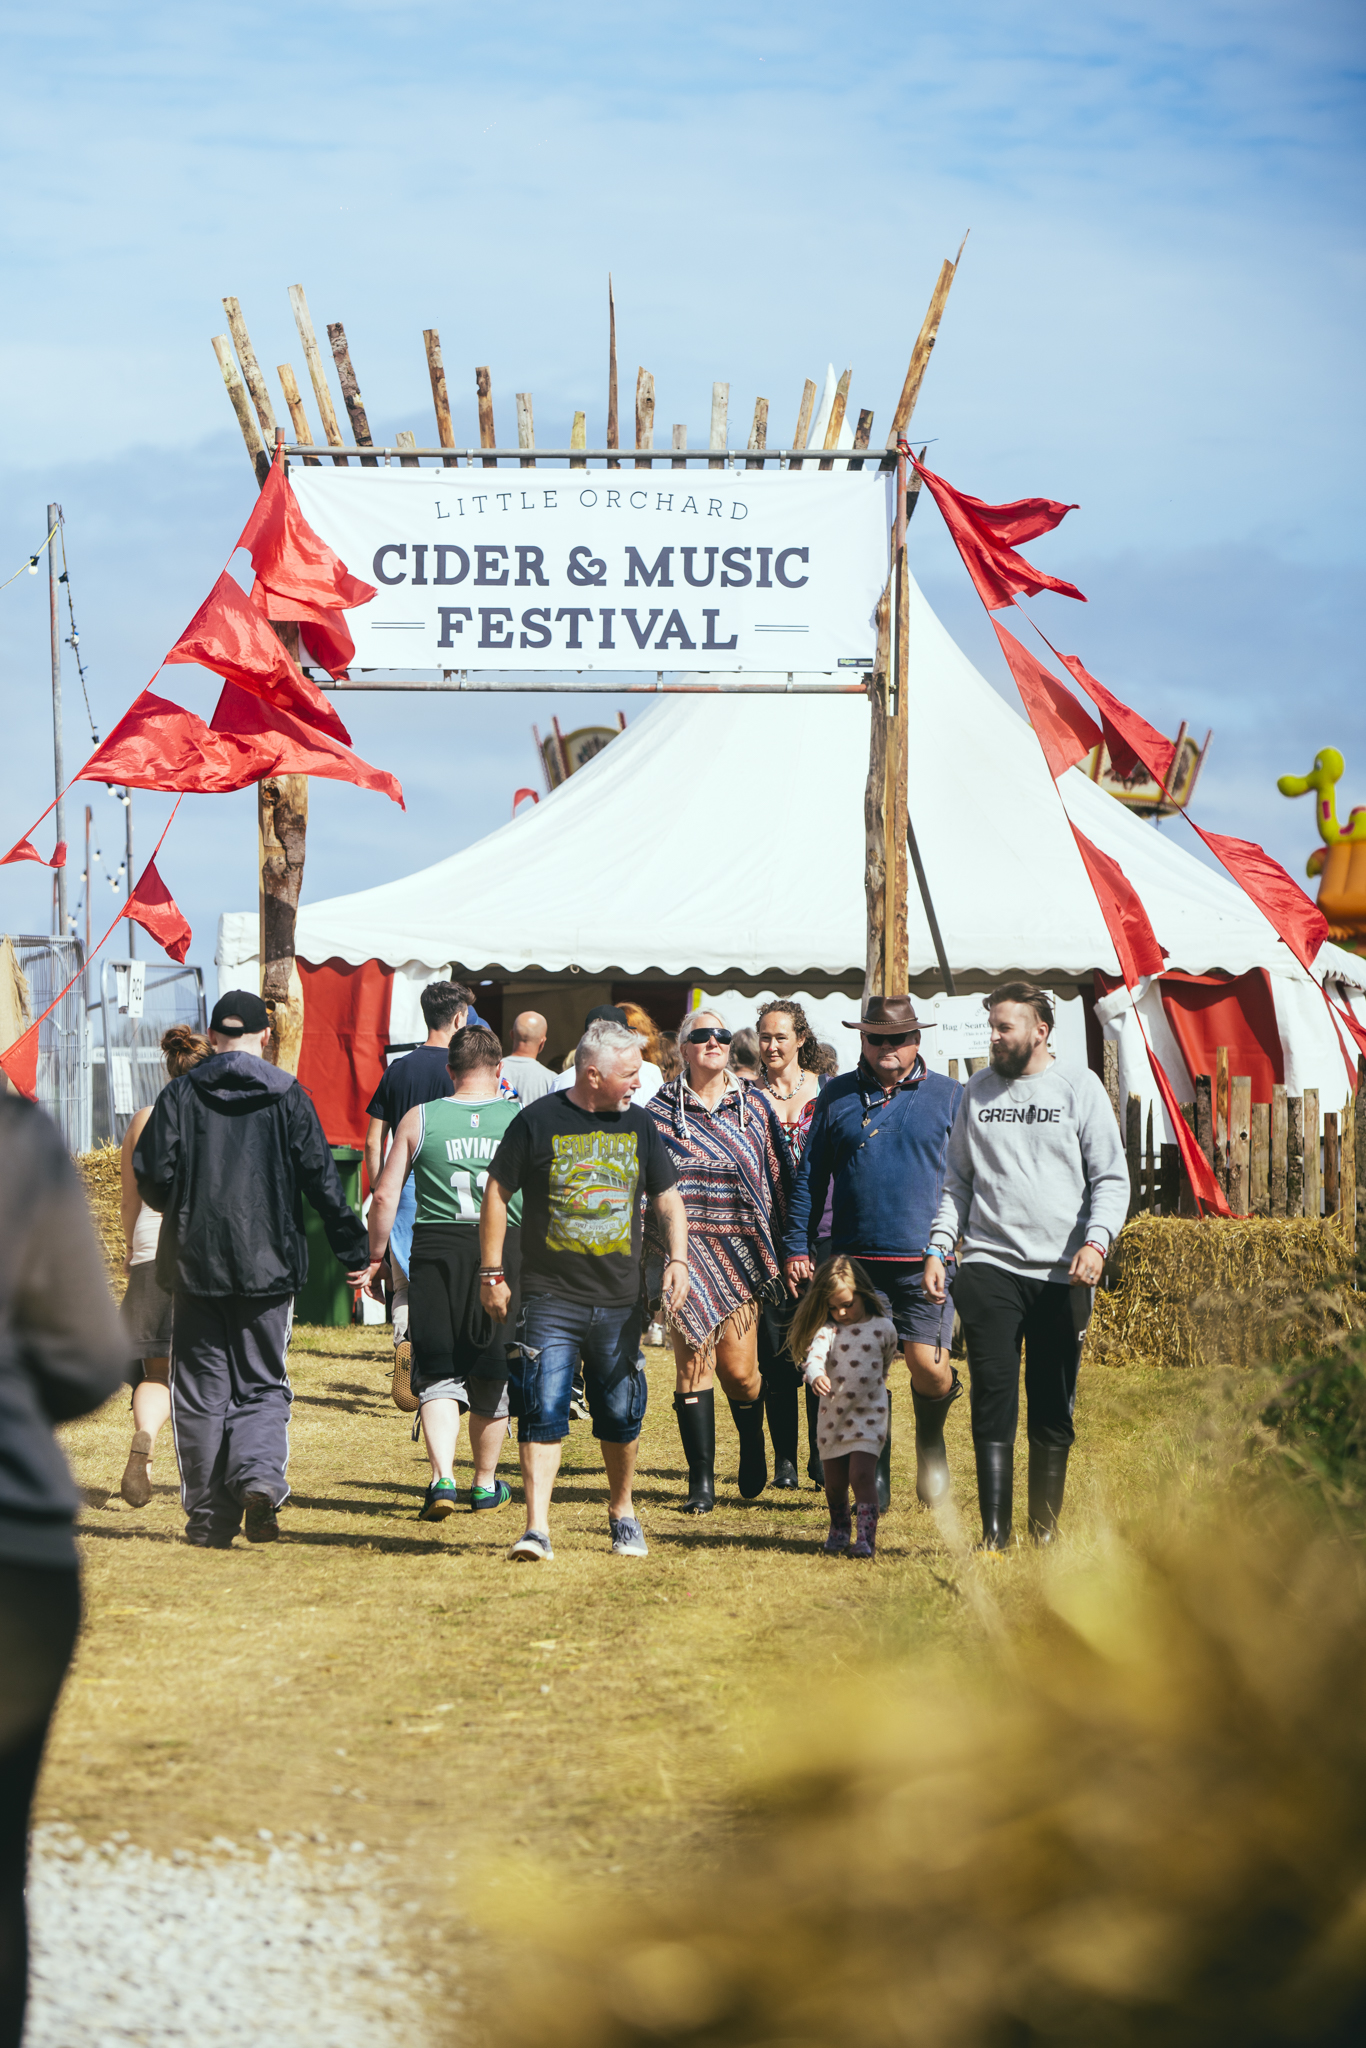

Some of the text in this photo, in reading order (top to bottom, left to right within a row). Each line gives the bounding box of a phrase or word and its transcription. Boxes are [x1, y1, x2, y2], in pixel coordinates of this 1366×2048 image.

[435, 489, 749, 521] LITTLE ORCHARD
[372, 544, 810, 589] CIDER & MUSIC
[437, 606, 739, 650] FESTIVAL
[942, 1023, 958, 1031] Bag
[554, 1130, 637, 1177] SALT ROCK
